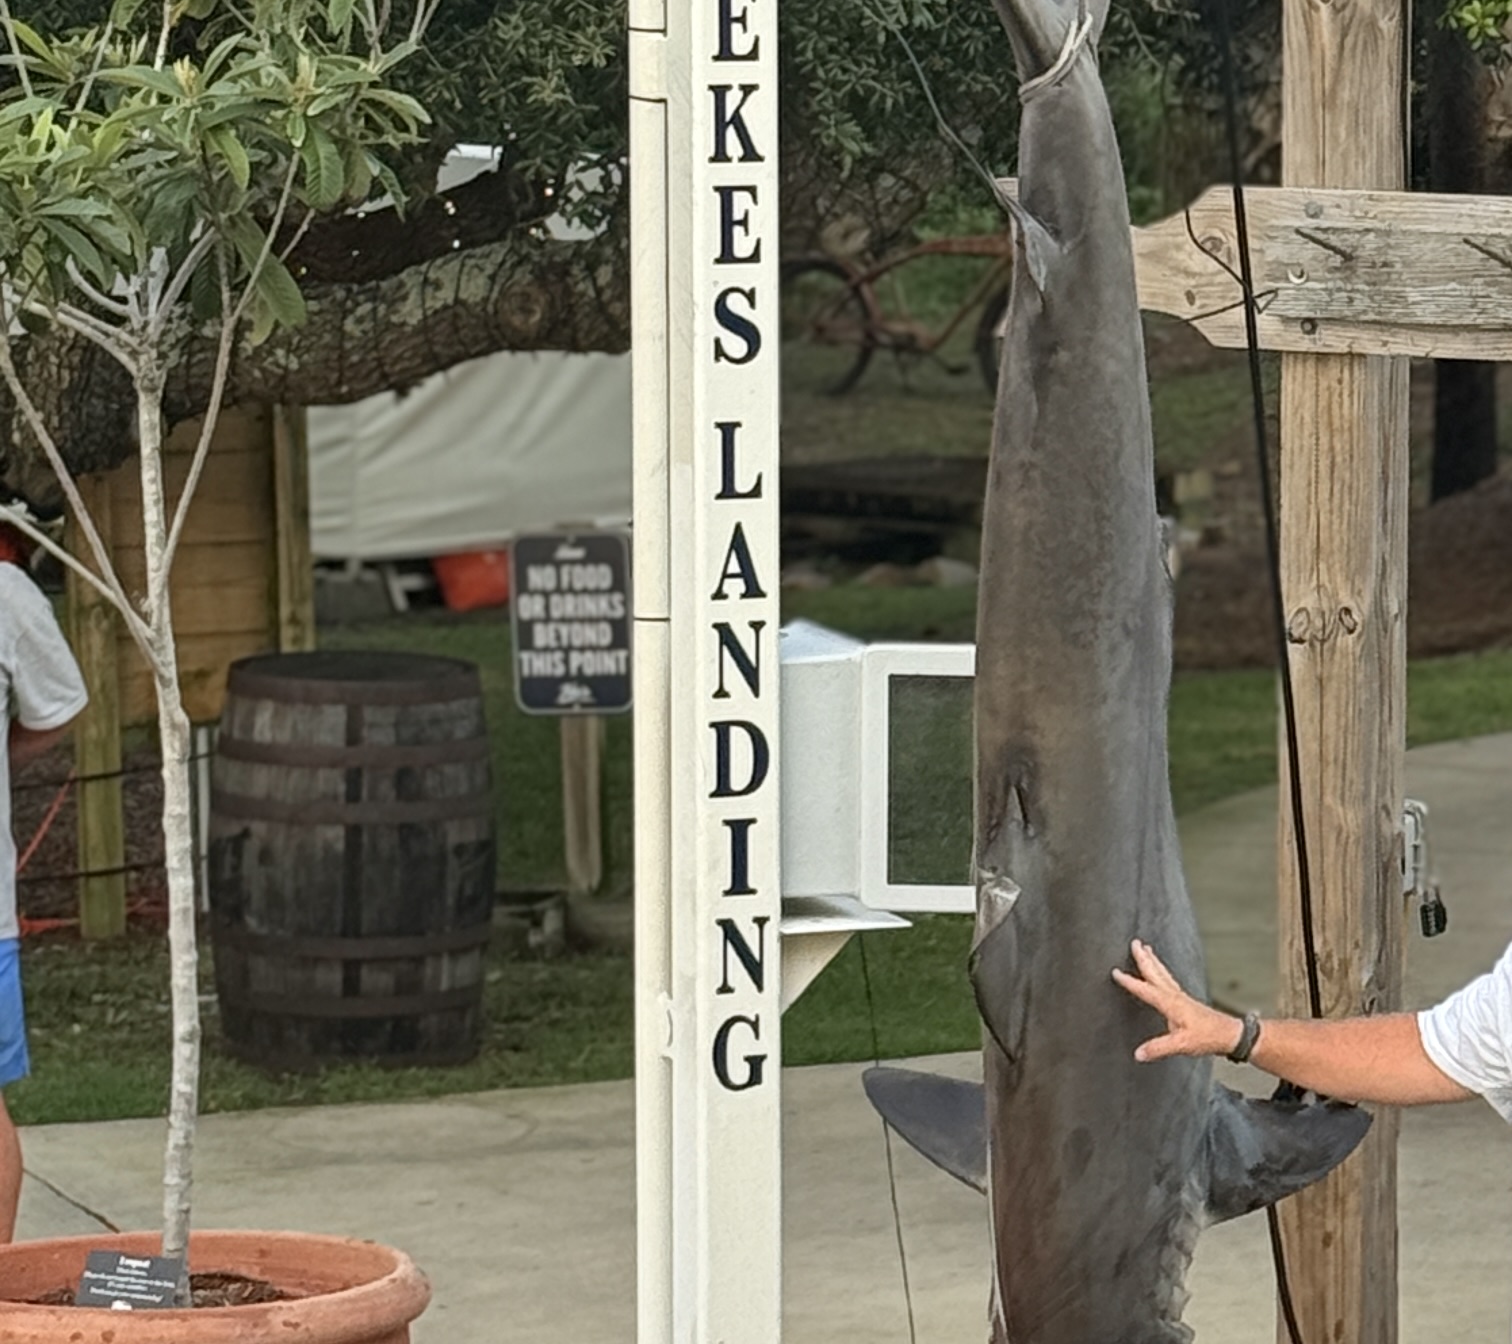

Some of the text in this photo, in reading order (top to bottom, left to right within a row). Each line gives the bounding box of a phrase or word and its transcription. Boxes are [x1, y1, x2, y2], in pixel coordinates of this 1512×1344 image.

[526, 563, 613, 592] NO FOOD
[517, 592, 625, 621] OR DRINKS
[532, 621, 613, 649] BEYOND
[519, 648, 629, 678] THIS POINT
[708, 421, 771, 1092] LANDING
